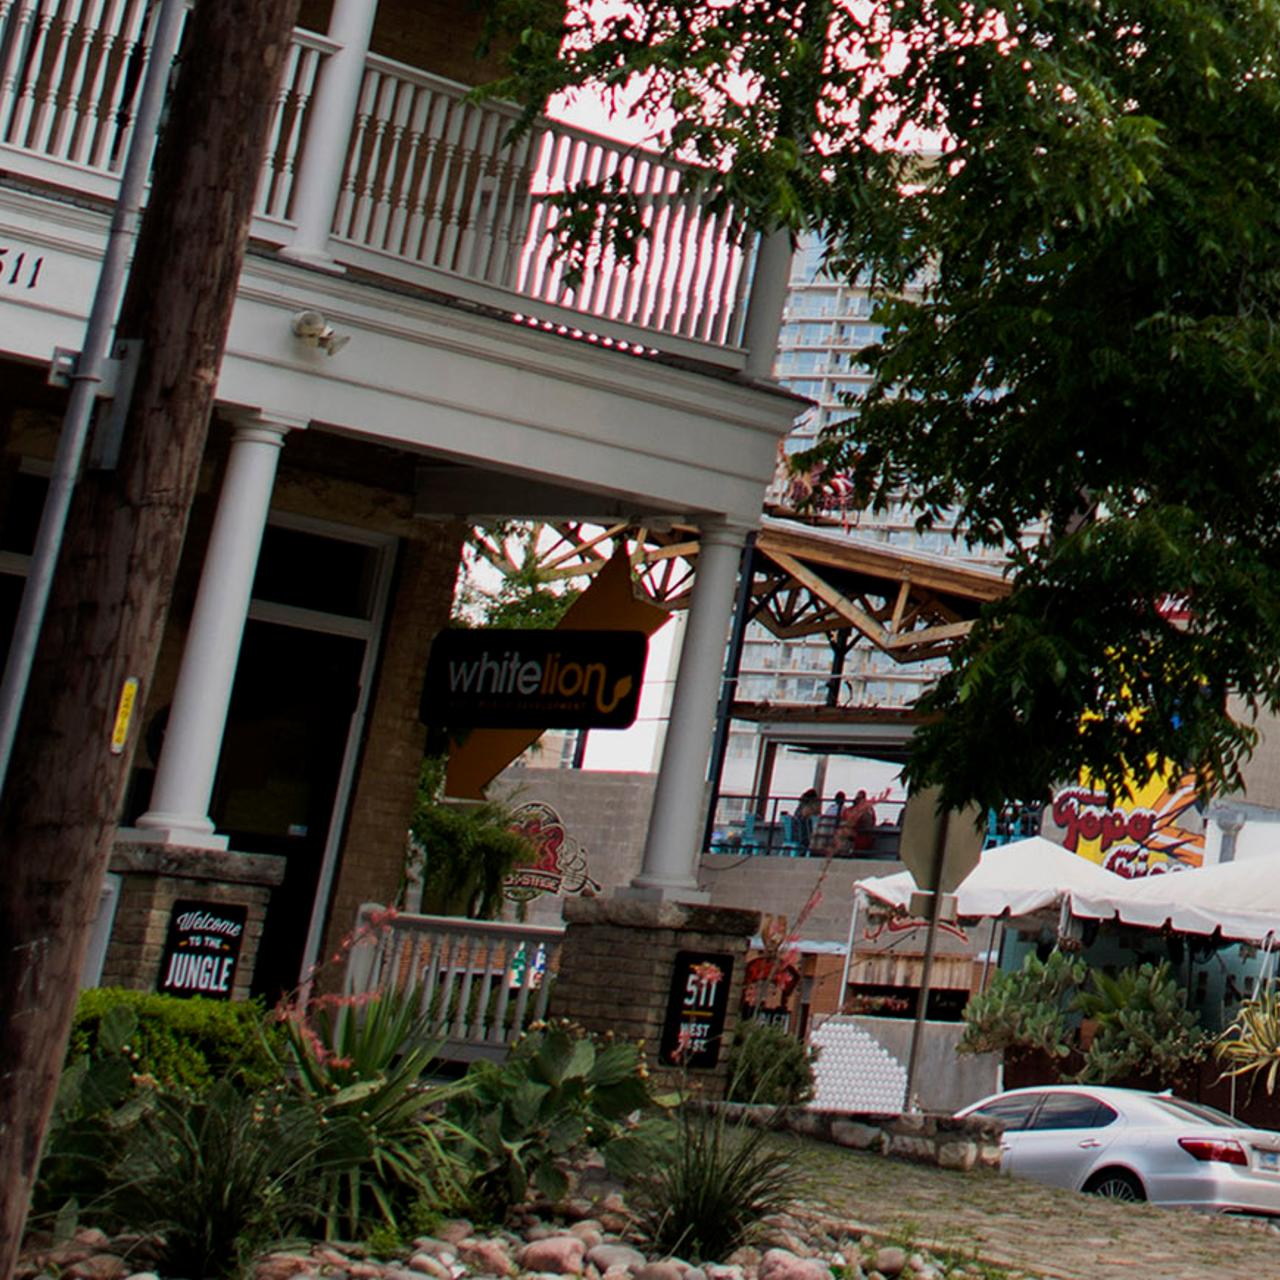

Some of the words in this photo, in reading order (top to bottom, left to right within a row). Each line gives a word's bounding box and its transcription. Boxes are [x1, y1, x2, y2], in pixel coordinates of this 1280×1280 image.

[449, 651, 622, 713] whitelion
[176, 910, 242, 937] Welcome
[189, 935, 202, 948] TO
[204, 935, 223, 950] THE
[164, 952, 235, 992] JUNGLE
[683, 973, 719, 1008] 511
